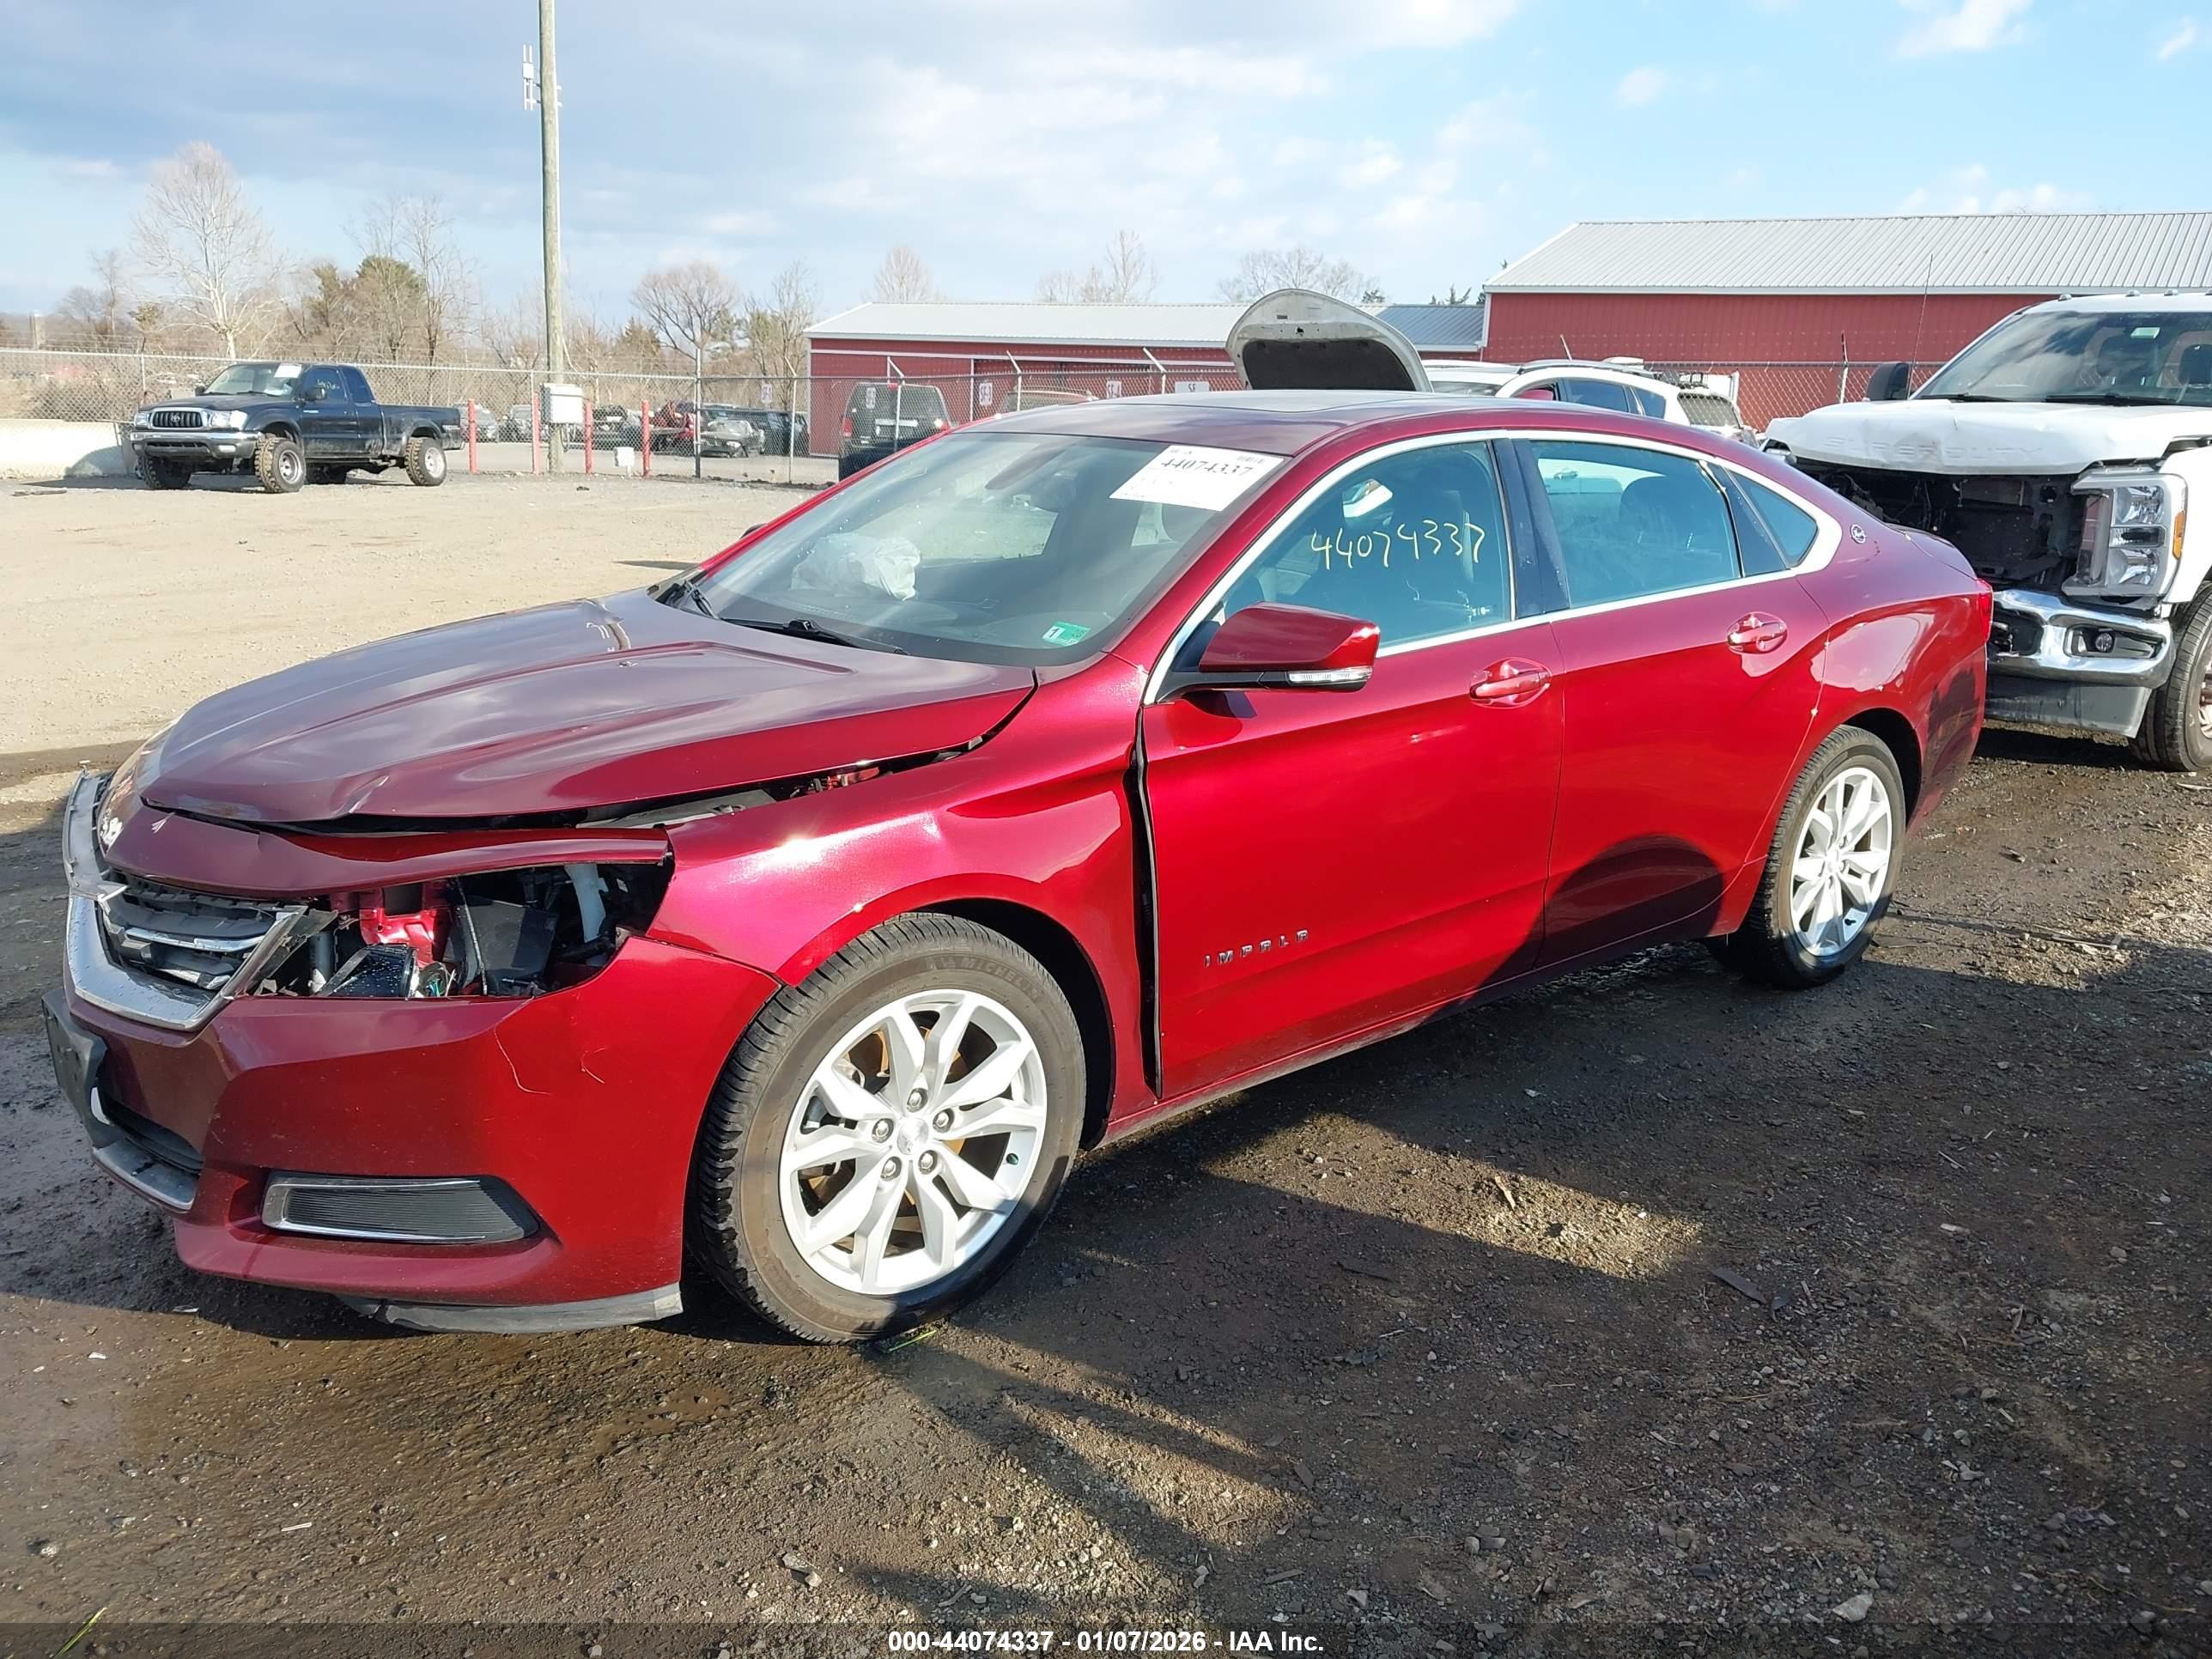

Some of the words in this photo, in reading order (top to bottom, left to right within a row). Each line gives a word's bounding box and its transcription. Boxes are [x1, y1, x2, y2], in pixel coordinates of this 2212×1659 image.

[1161, 458, 1254, 476] 44074337
[1310, 519, 1486, 570] 44074337
[1203, 929, 1309, 968] IMPALA
